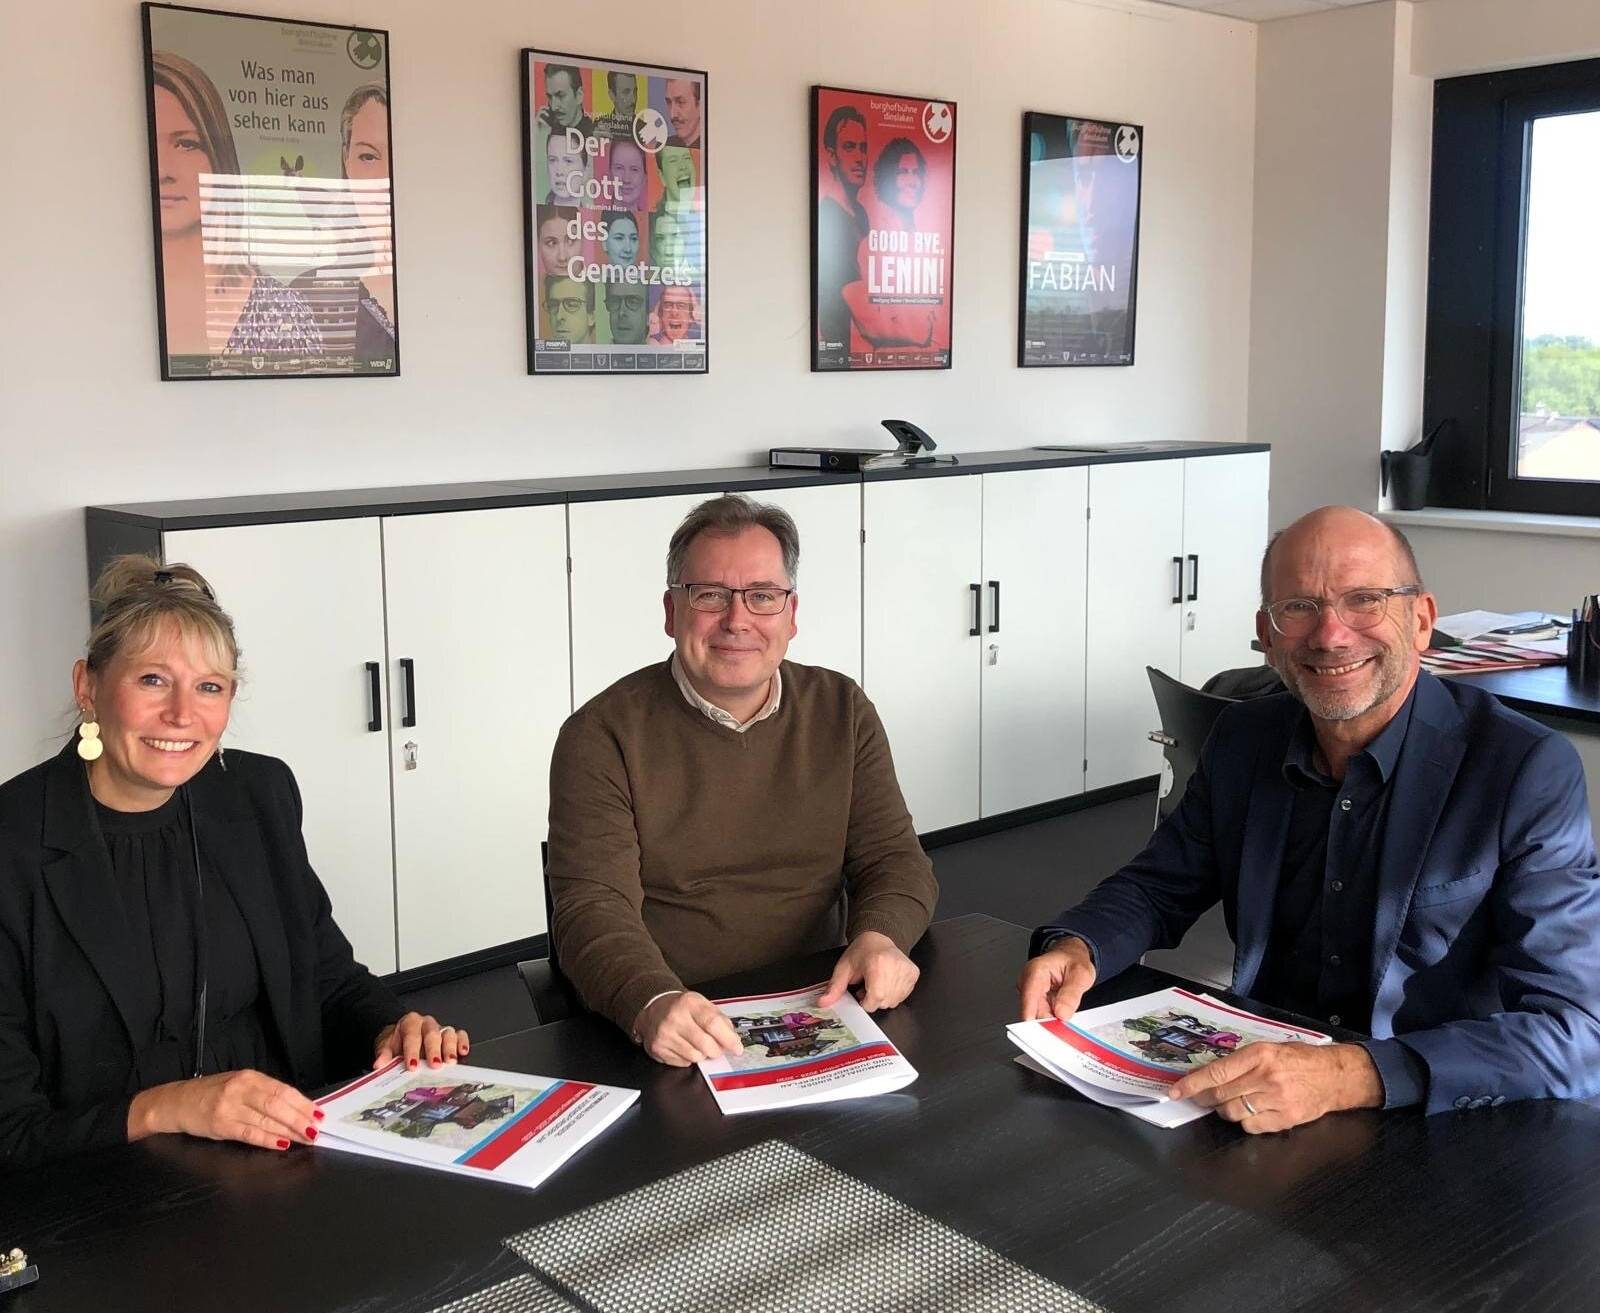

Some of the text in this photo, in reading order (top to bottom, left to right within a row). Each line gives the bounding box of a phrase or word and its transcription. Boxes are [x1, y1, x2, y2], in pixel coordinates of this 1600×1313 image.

[241, 60, 315, 85] Was man
[228, 87, 329, 110] von hier aus
[233, 110, 326, 135] sehen kann
[565, 127, 610, 157] Der
[566, 170, 623, 201] Gott
[566, 212, 609, 242] des
[868, 229, 909, 253] GOOD
[567, 255, 693, 286] Gemetzels
[868, 255, 945, 295] LENIN!
[1029, 261, 1116, 292] FABIAN
